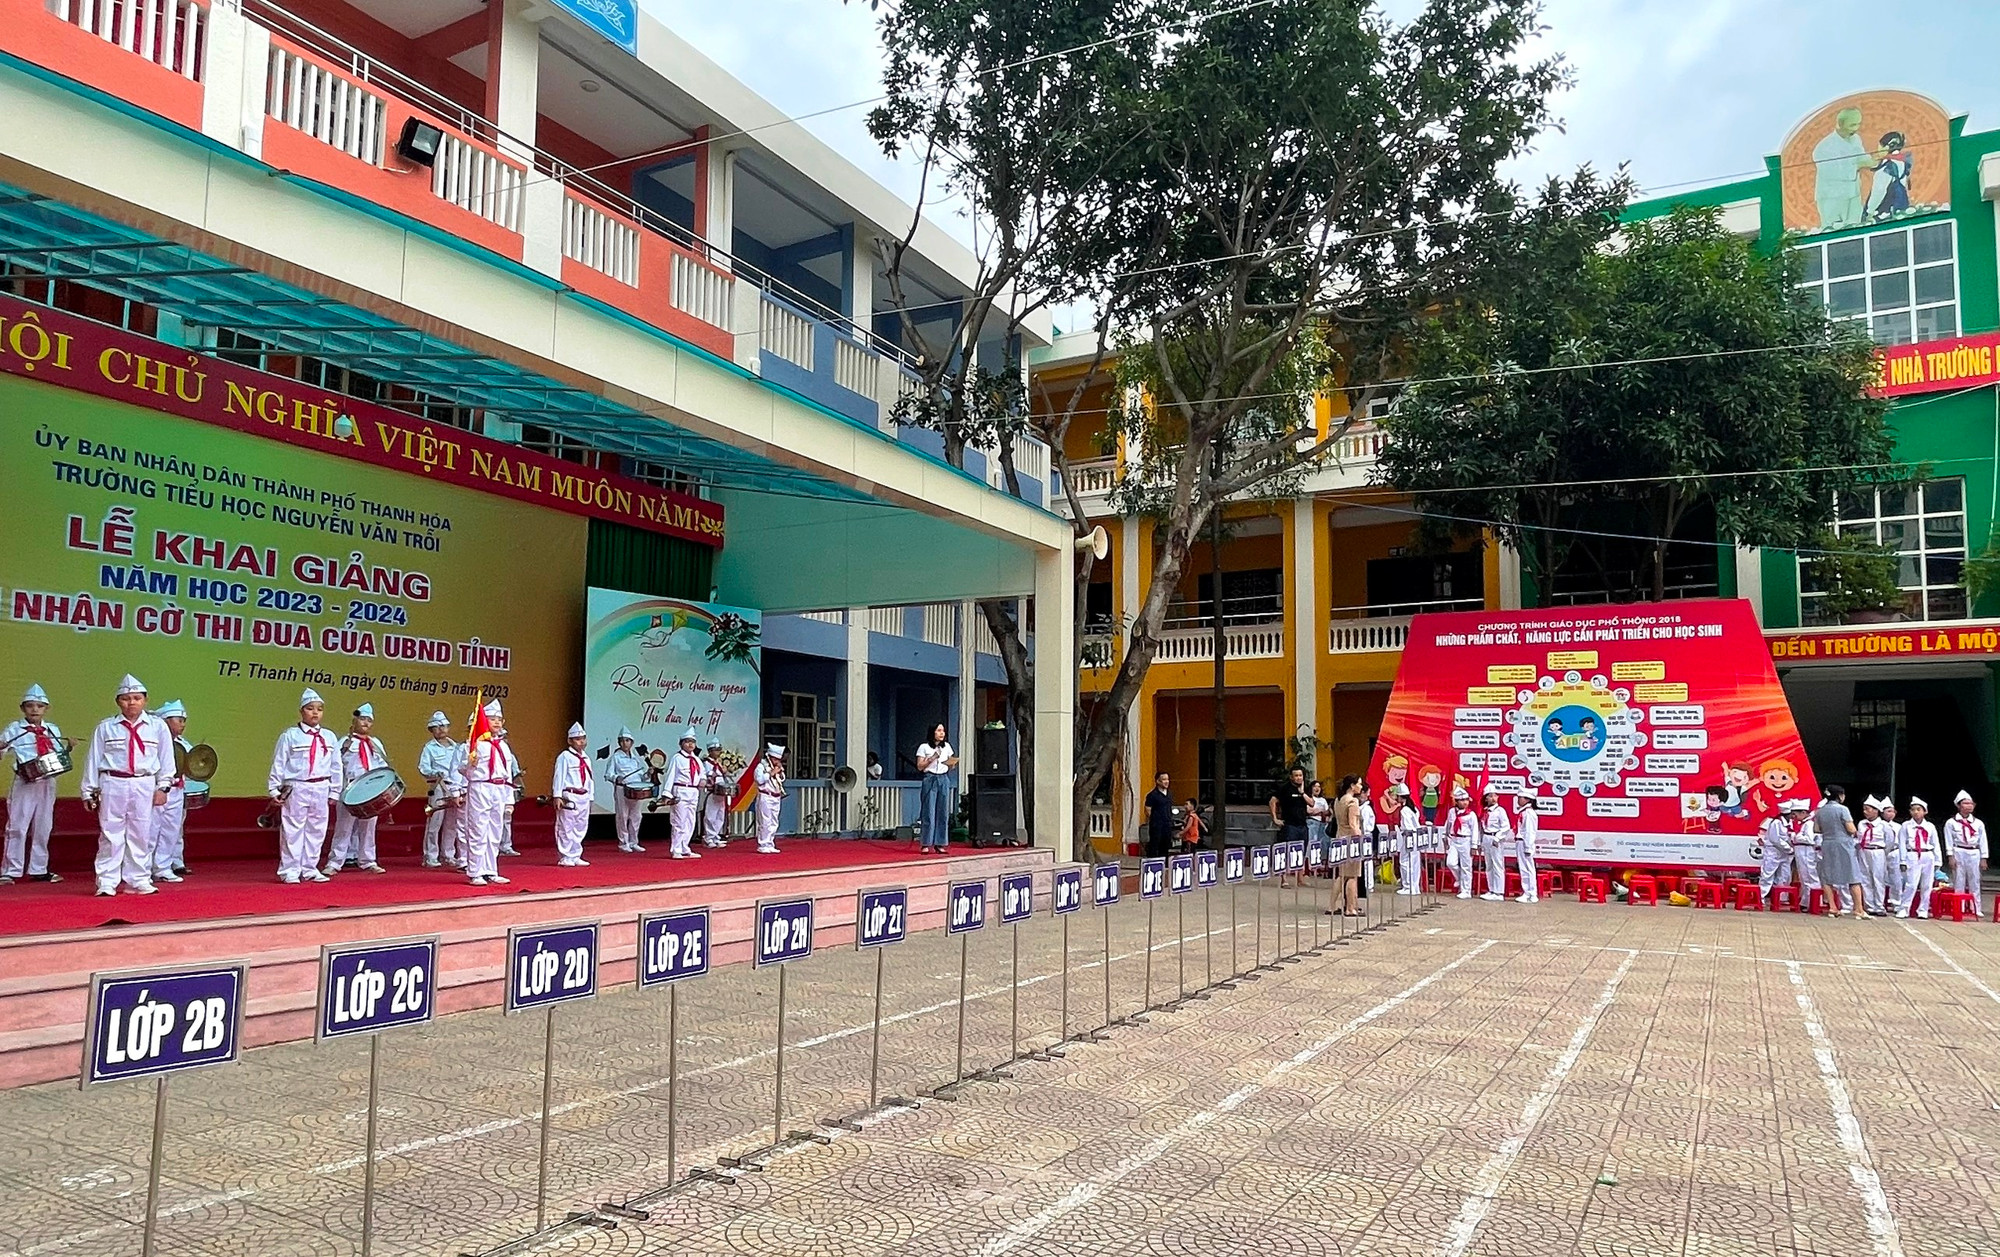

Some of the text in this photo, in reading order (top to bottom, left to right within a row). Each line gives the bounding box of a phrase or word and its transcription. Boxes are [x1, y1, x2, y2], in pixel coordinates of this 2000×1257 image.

[1891, 349, 1924, 386] NHÀ
[1927, 343, 1991, 381] TRƯỜNG
[0, 311, 74, 371] ỘI
[99, 347, 207, 403] CHỦ
[375, 421, 461, 473] VIỆT
[469, 449, 542, 492] NAM
[550, 471, 632, 514] MUÔN
[638, 494, 699, 532] NĂM!
[35, 424, 451, 531] ỦY BAN NHÂN DÂN THÀNH PHỐ THANH HÓA
[52, 461, 440, 552] TRƯỜNG TIỂU HỌC NGUYỄN VĂN TRỖI
[67, 506, 430, 600] LỄ KHAI GIẢNG
[101, 565, 178, 596] NĂM
[188, 578, 248, 606] HỌC
[257, 588, 323, 614] 2023
[349, 601, 406, 625] 2024
[13, 591, 511, 671] NHẬN CỜ THI ĐUA CỦA UBND TỈNH
[1478, 616, 1681, 631] CHƯƠNG TRÌNH GIÁO DỤC PHỔ THÔNG 2018
[1525, 630, 1551, 643] NĂNG
[1553, 630, 1571, 645] LỰC
[1596, 626, 1619, 641] PHÁT
[1622, 625, 1650, 640] TRIỂN
[1652, 627, 1672, 639] CHO
[1674, 626, 1695, 640] HỌC
[1697, 624, 1723, 637] SINH
[1772, 628, 2000, 656] ĐẾN TRƯỜNG LÀ MỘ
[218, 660, 241, 677] TP.
[248, 663, 297, 682] Thanh
[302, 669, 335, 687] Hóa,
[340, 673, 376, 691] ngày
[380, 675, 396, 689] 05
[400, 678, 437, 695] tháng
[441, 681, 448, 693] 9
[482, 685, 509, 698] 2023
[610, 664, 650, 696] Rèn
[1581, 741, 1589, 750] C
[1004, 882, 1019, 916] LỚP
[1057, 876, 1069, 907] LỚP
[1096, 871, 1108, 900] LỚP
[864, 899, 887, 939] LỚP
[953, 889, 982, 926] LỚP 1A
[648, 924, 702, 974] LỚP 2E
[764, 911, 809, 955] LỚP 2H
[519, 941, 590, 997] LỚP 2D
[335, 959, 425, 1023] LỚP 2C
[106, 989, 226, 1064] LỚP 2B
